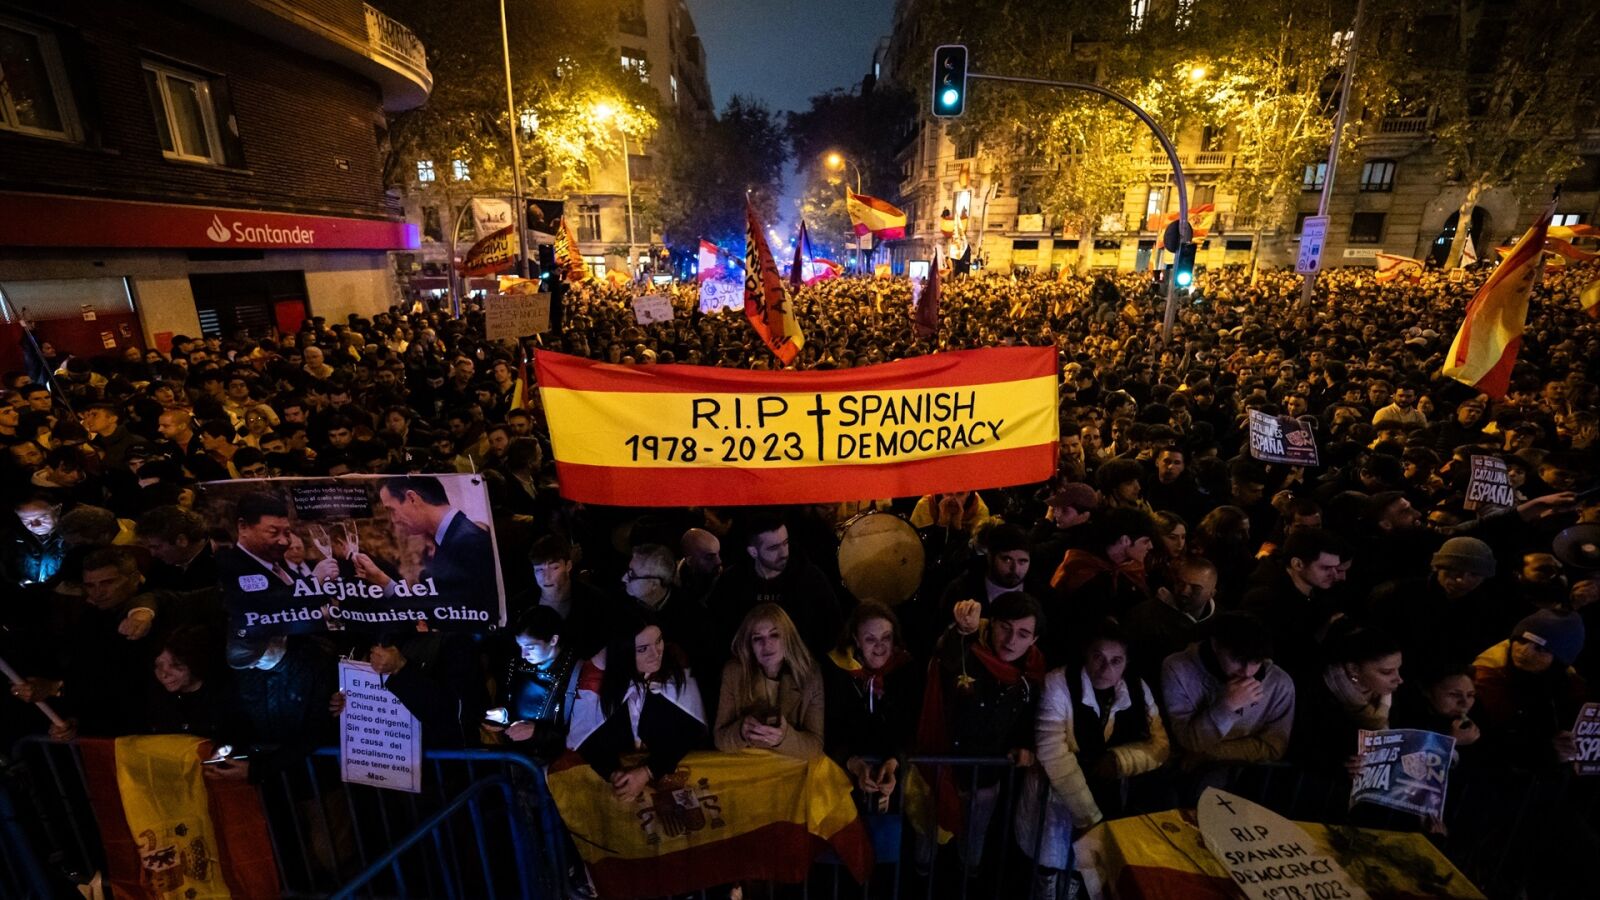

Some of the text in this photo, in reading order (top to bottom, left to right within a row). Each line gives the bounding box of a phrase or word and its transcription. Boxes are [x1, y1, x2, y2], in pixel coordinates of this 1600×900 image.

[232, 222, 314, 244] Santander
[692, 396, 788, 429] R.I.P
[839, 391, 976, 426] SPANISH
[836, 419, 1005, 458] DEMOCRACY
[1252, 432, 1285, 455] ESPAÑA
[1470, 481, 1514, 506] ESPAÑA
[293, 576, 438, 601] Aléjate del
[244, 605, 490, 627] Partido Comunista Chino
[346, 690, 388, 703] Comunista
[351, 702, 373, 711] China
[347, 714, 372, 723] núcleo
[347, 723, 411, 740] Sin este núcleo
[352, 748, 393, 760] socialismo
[361, 738, 383, 747] causa
[390, 741, 402, 749] del
[347, 758, 369, 767] puede
[372, 761, 390, 770] tener
[366, 772, 388, 781] -Mao-
[1224, 842, 1308, 866] SPANISH
[1232, 859, 1333, 884] DEMOCRACY
